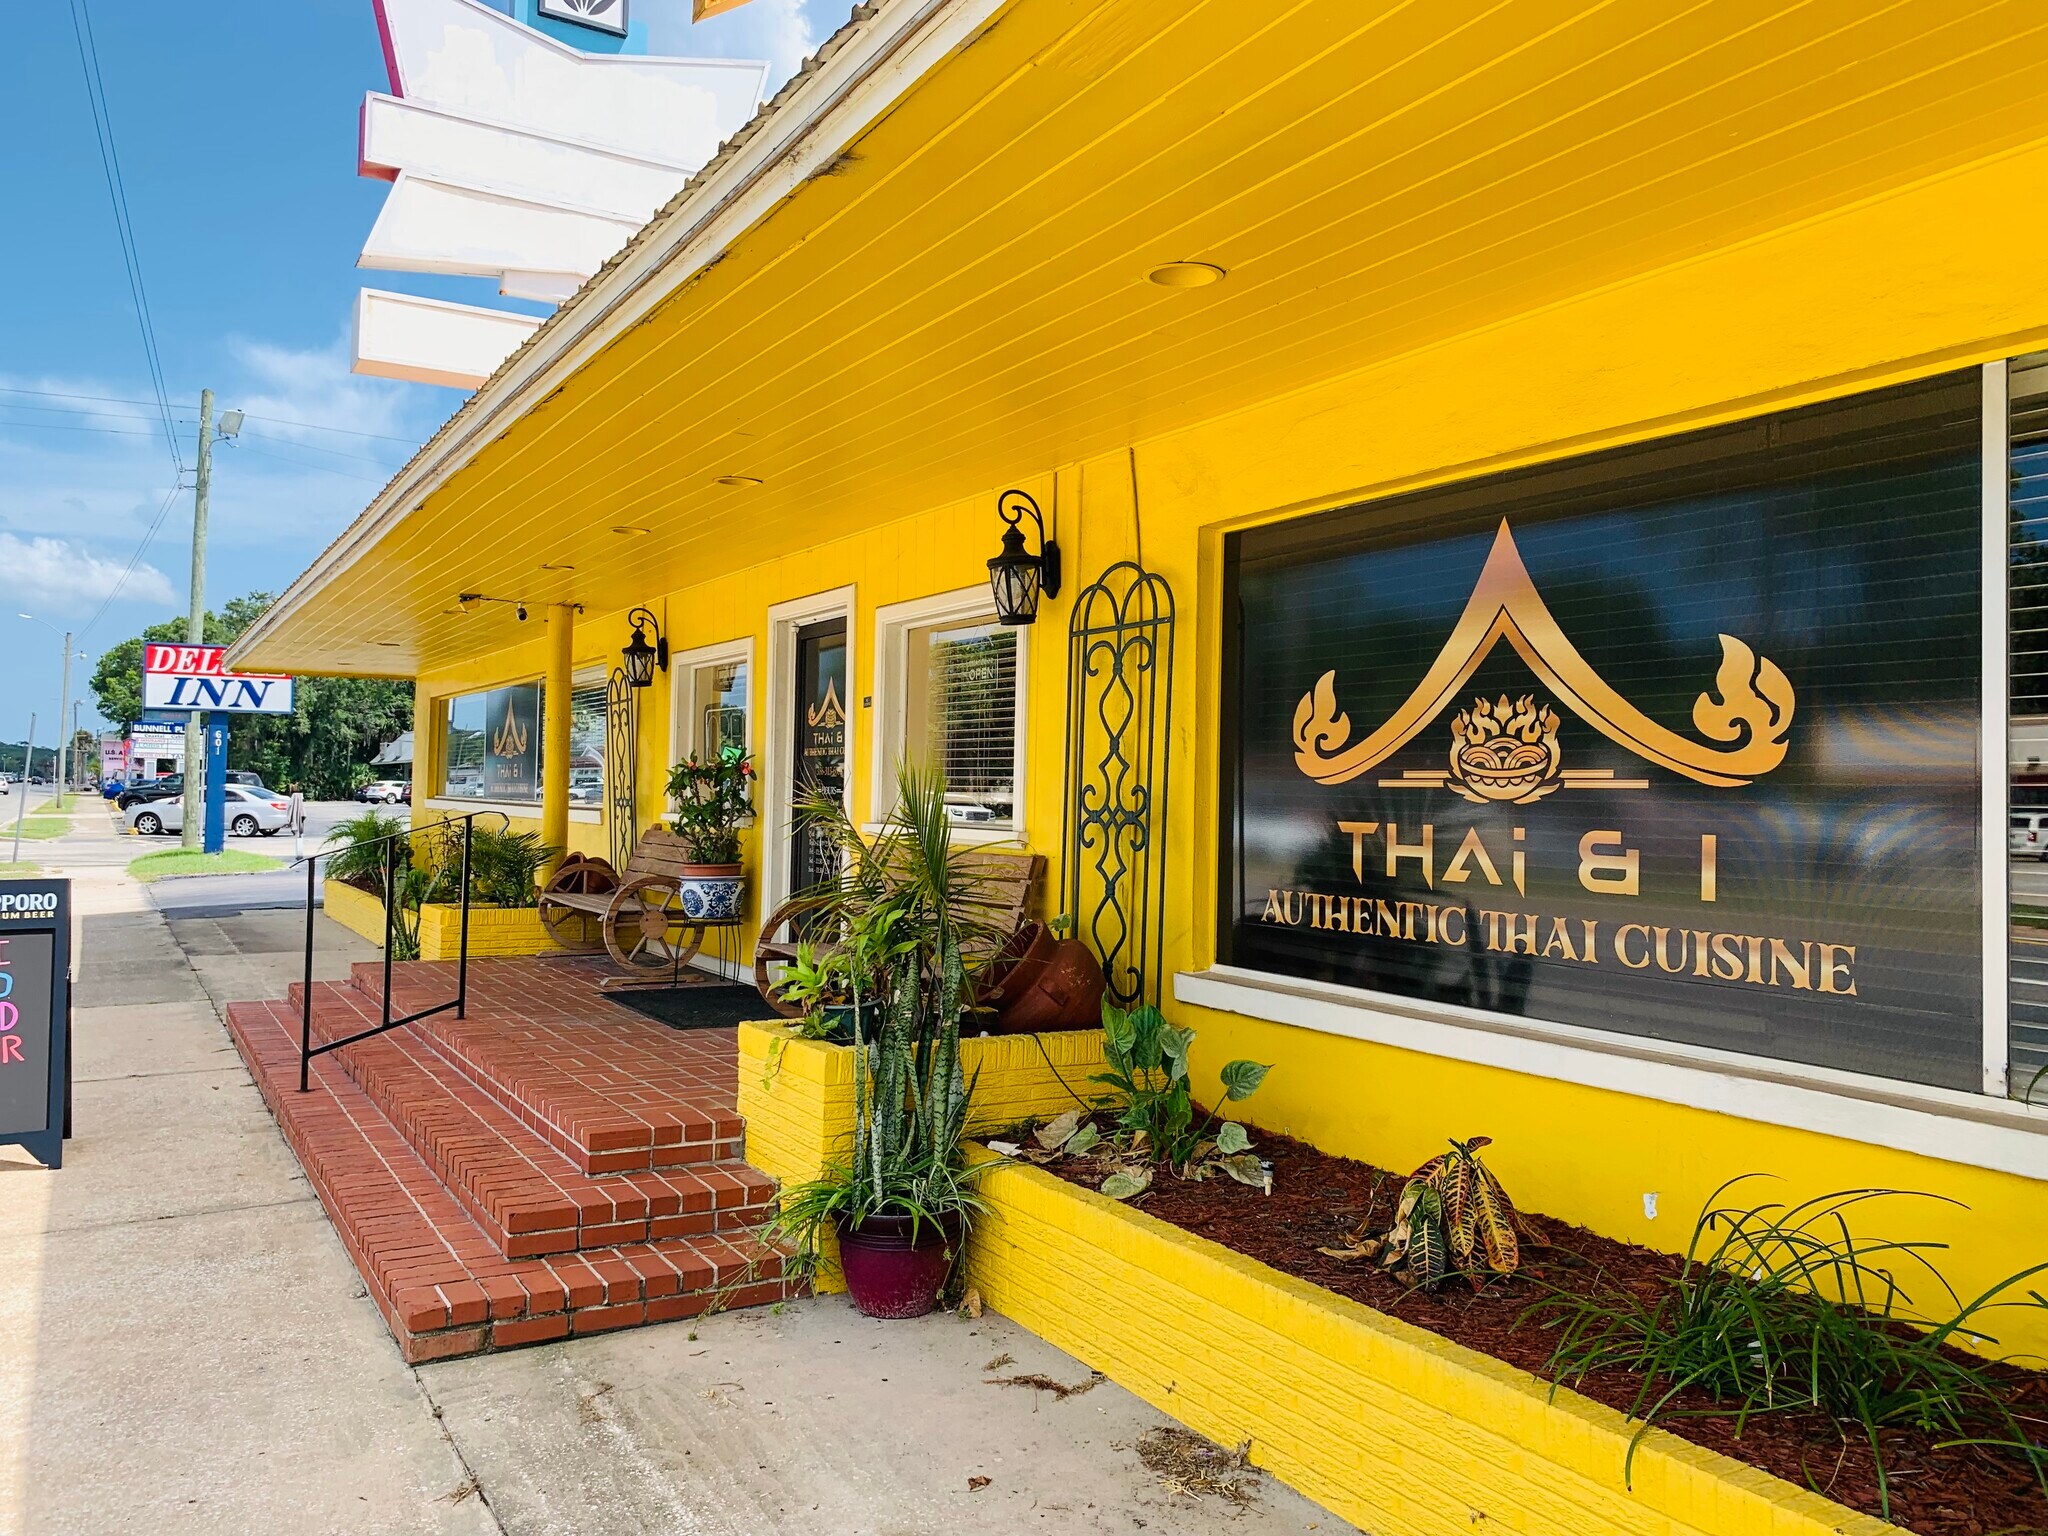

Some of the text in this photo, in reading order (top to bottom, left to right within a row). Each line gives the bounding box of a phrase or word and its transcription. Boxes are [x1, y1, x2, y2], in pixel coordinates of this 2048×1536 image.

[148, 646, 286, 677] DEL
[969, 666, 994, 680] OPEN
[164, 677, 275, 708] INN
[133, 724, 172, 733] BUNNELL
[1577, 830, 1640, 897] &
[1701, 833, 1718, 902] I
[0, 893, 58, 912] PORO
[0, 910, 54, 920] UM BEER
[1260, 888, 1858, 997] AUTHENTIC THAI CUISINE
